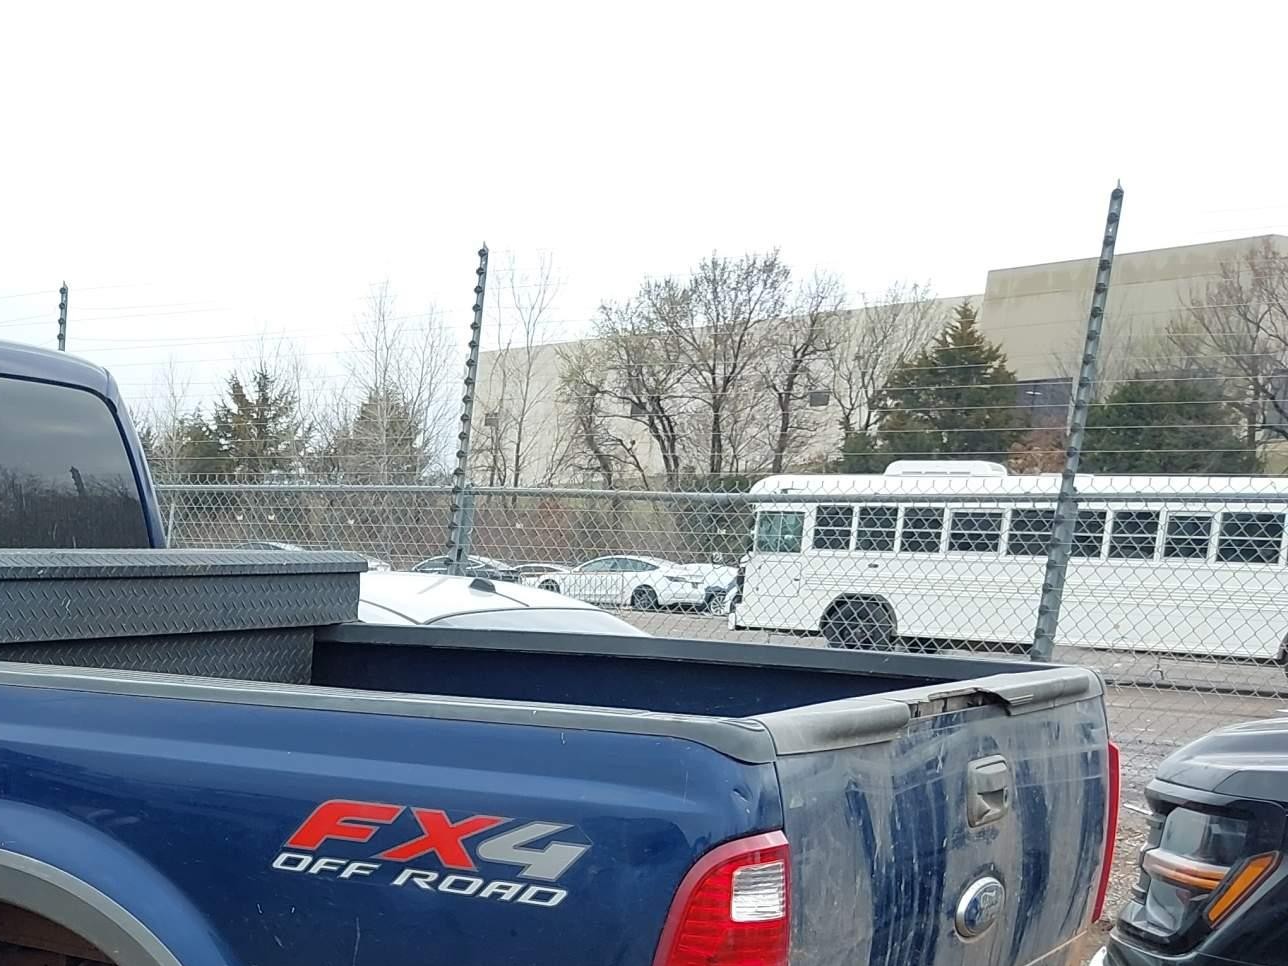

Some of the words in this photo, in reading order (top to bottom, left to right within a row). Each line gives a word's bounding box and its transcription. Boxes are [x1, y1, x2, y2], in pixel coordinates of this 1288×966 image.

[283, 800, 592, 881] FX4
[272, 852, 382, 880] OFF
[391, 867, 569, 907] ROAD
